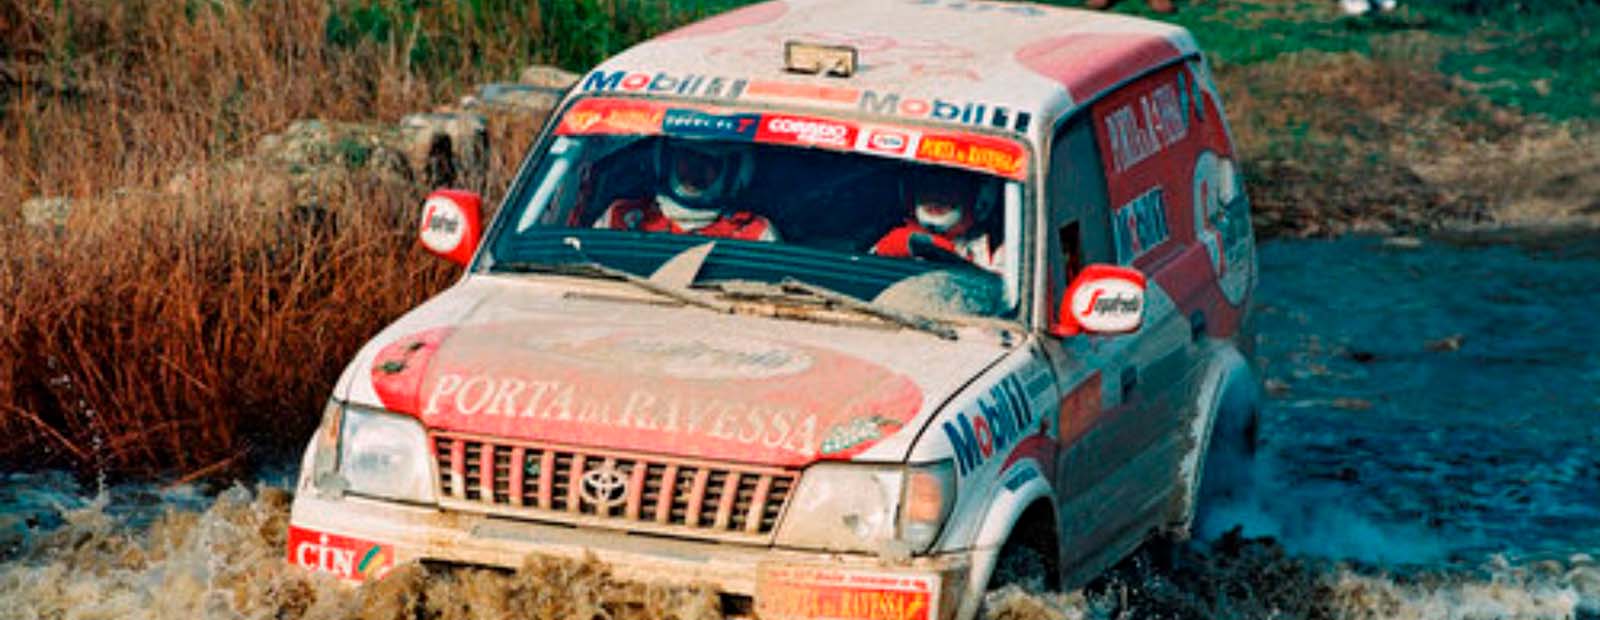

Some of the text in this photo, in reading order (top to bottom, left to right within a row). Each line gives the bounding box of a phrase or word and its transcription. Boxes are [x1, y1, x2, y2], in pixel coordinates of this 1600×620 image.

[583, 71, 700, 96] Mobil
[860, 90, 986, 125] Mobil
[423, 372, 577, 422] PORTA
[617, 390, 820, 456] RAVESSA
